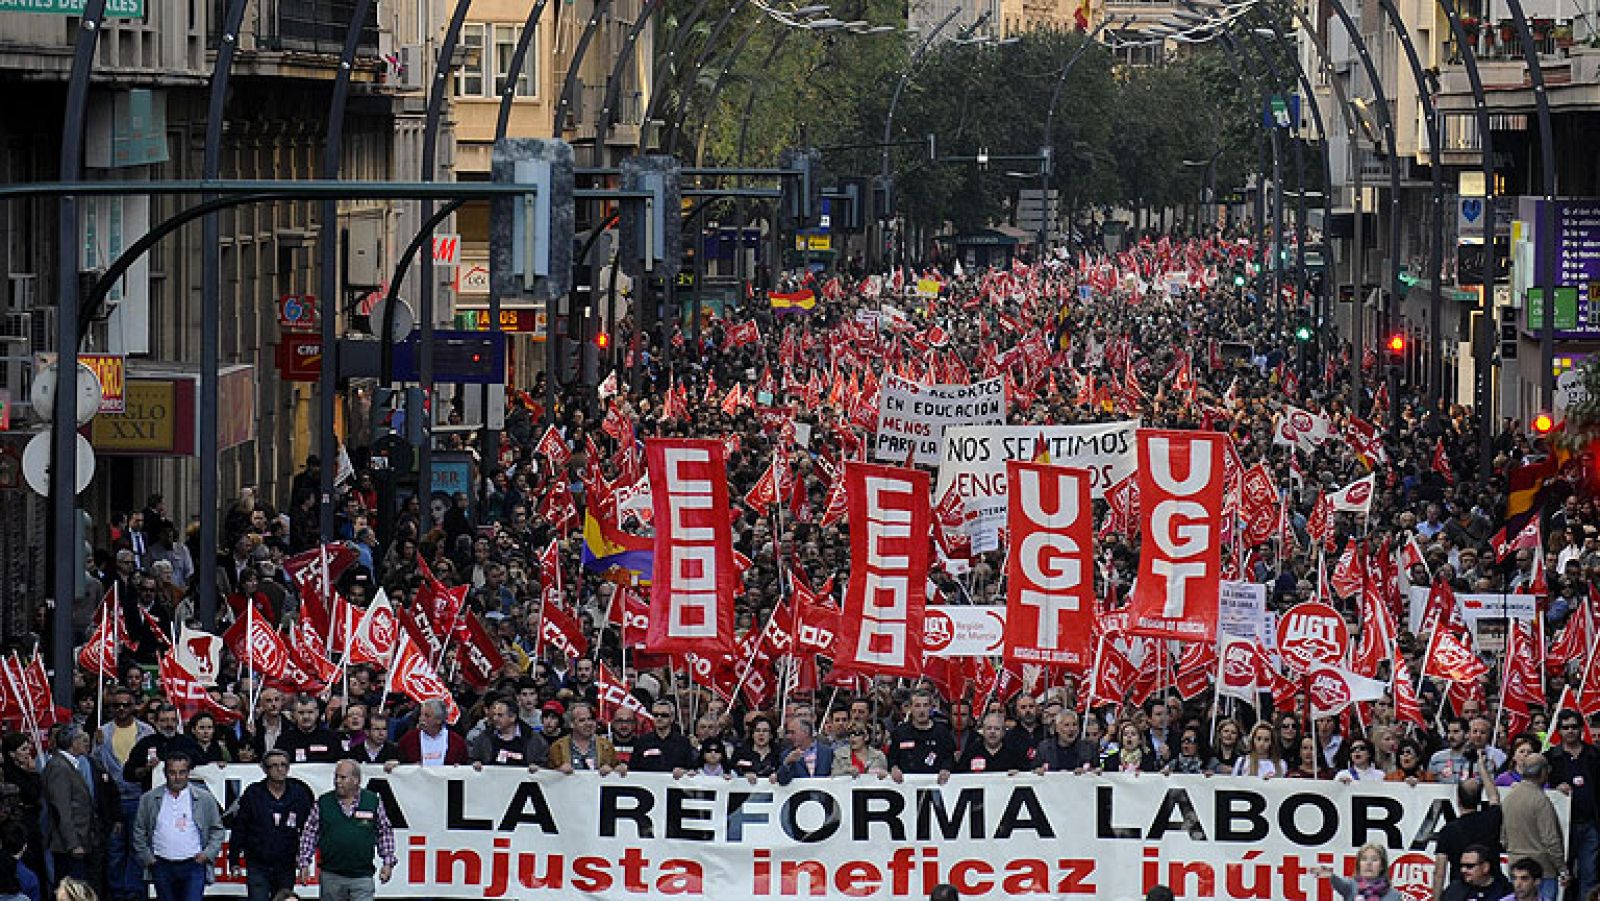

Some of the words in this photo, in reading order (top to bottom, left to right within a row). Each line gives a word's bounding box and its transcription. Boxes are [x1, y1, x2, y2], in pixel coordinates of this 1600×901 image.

[110, 420, 157, 439] XXI
[882, 417, 932, 437] MENOS
[914, 397, 1000, 418] EDUCACIÓN
[947, 437, 991, 462] NOS
[664, 447, 718, 637] CCOO
[1148, 436, 1214, 618] UGT
[855, 475, 914, 669] CCOO
[1018, 469, 1083, 649] UGT
[1286, 614, 1339, 643] UGT
[446, 779, 560, 836] LA
[598, 784, 1057, 844] REFORMA
[1095, 785, 1465, 851] LABORA
[408, 836, 704, 898] injusta
[752, 846, 1096, 897] ineficaz
